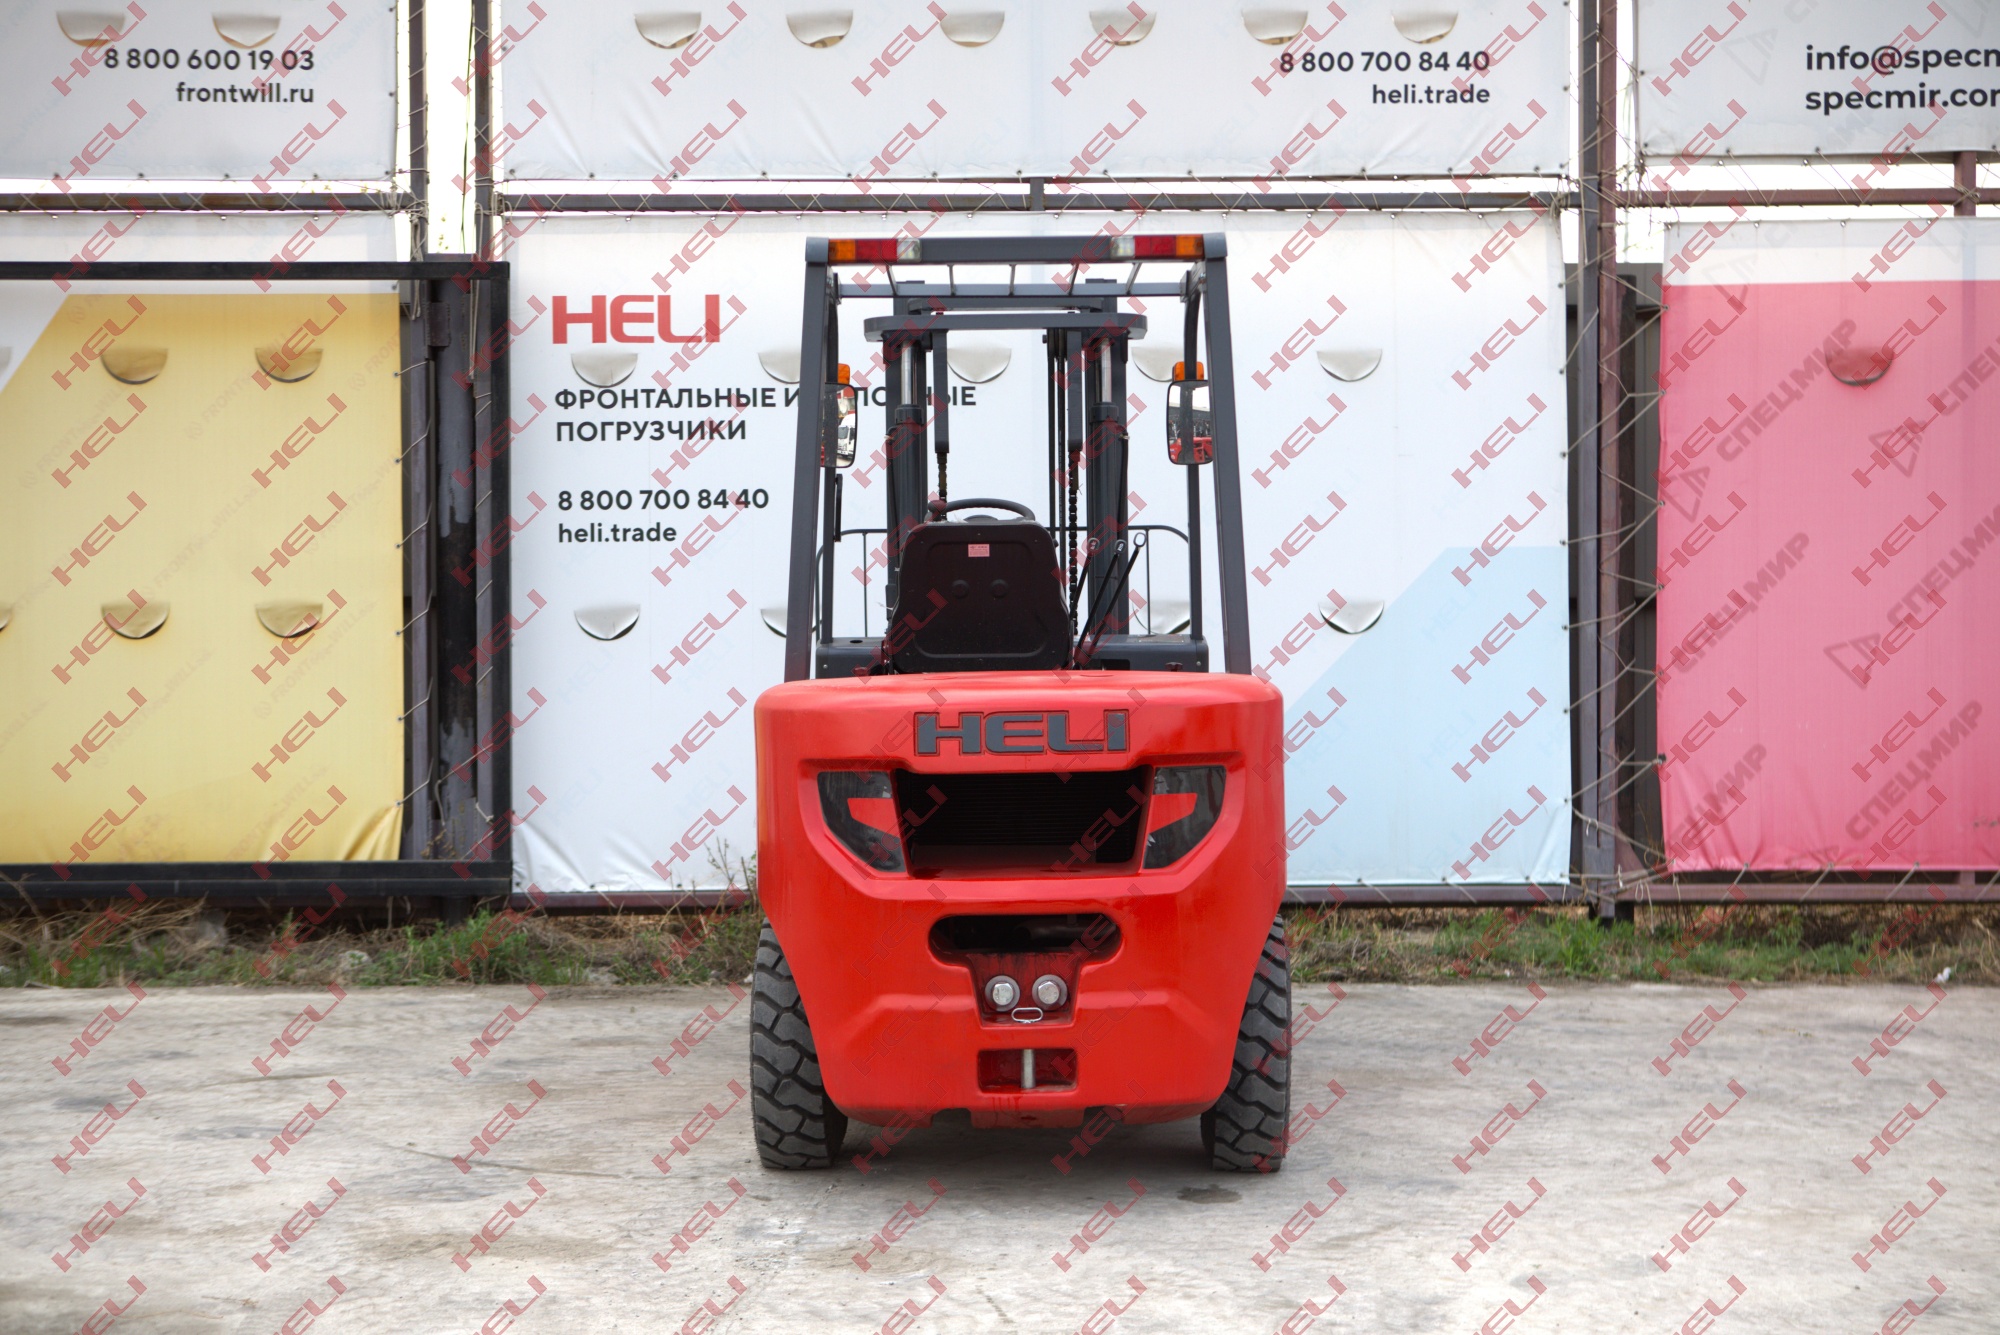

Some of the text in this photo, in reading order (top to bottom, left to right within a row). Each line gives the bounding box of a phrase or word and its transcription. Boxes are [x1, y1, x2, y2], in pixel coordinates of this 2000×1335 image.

[104, 48, 314, 70] 8 800 600 19 03
[1280, 51, 1490, 73] 8 800 700 84 40
[176, 81, 314, 103] frontwill.ru
[1372, 84, 1490, 104] heli.trade
[552, 294, 720, 344] HELI
[554, 387, 776, 410] ФРОНТАЛЬНЫЕ
[1716, 318, 1857, 462] СПЕЦМИР
[556, 420, 746, 442] ПОГРУЗЧИКИ
[558, 488, 769, 511] 8 800 700 84 40
[558, 522, 677, 543] heli.trade
[914, 709, 1129, 756] HELI
[1845, 700, 1983, 840] СПЕЦМИР
